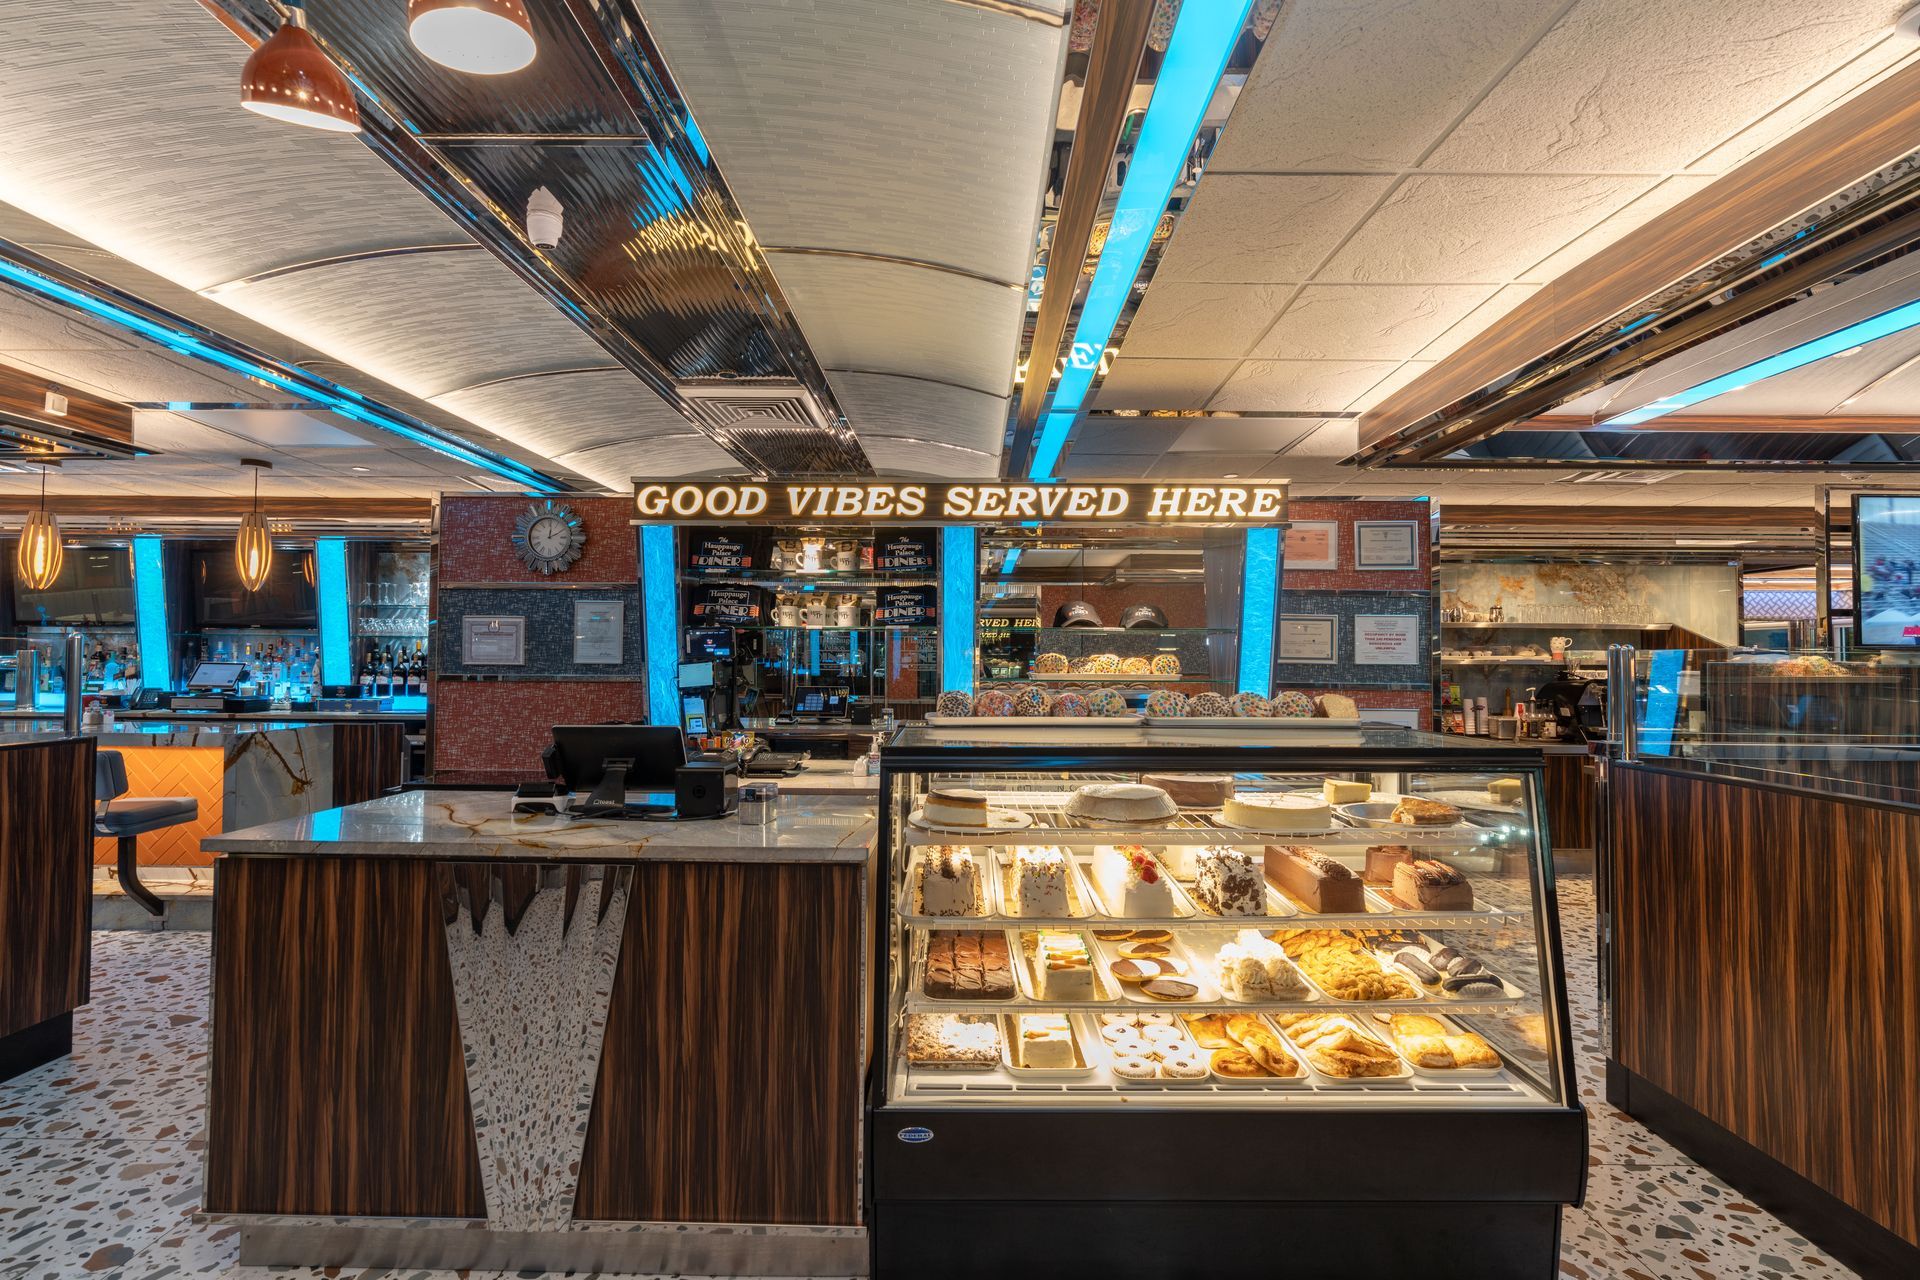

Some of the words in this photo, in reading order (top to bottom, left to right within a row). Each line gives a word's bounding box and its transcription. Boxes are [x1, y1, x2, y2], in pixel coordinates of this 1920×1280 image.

[637, 486, 767, 516] GOOD
[786, 486, 926, 516] VIBES
[943, 487, 1129, 517] SERVED
[1147, 487, 1282, 517] HERE
[704, 542, 741, 551] Hauppauge
[698, 556, 741, 566] DINER
[884, 557, 927, 567] DINER
[710, 590, 748, 599] Hauppauge
[884, 607, 926, 618] DINER
